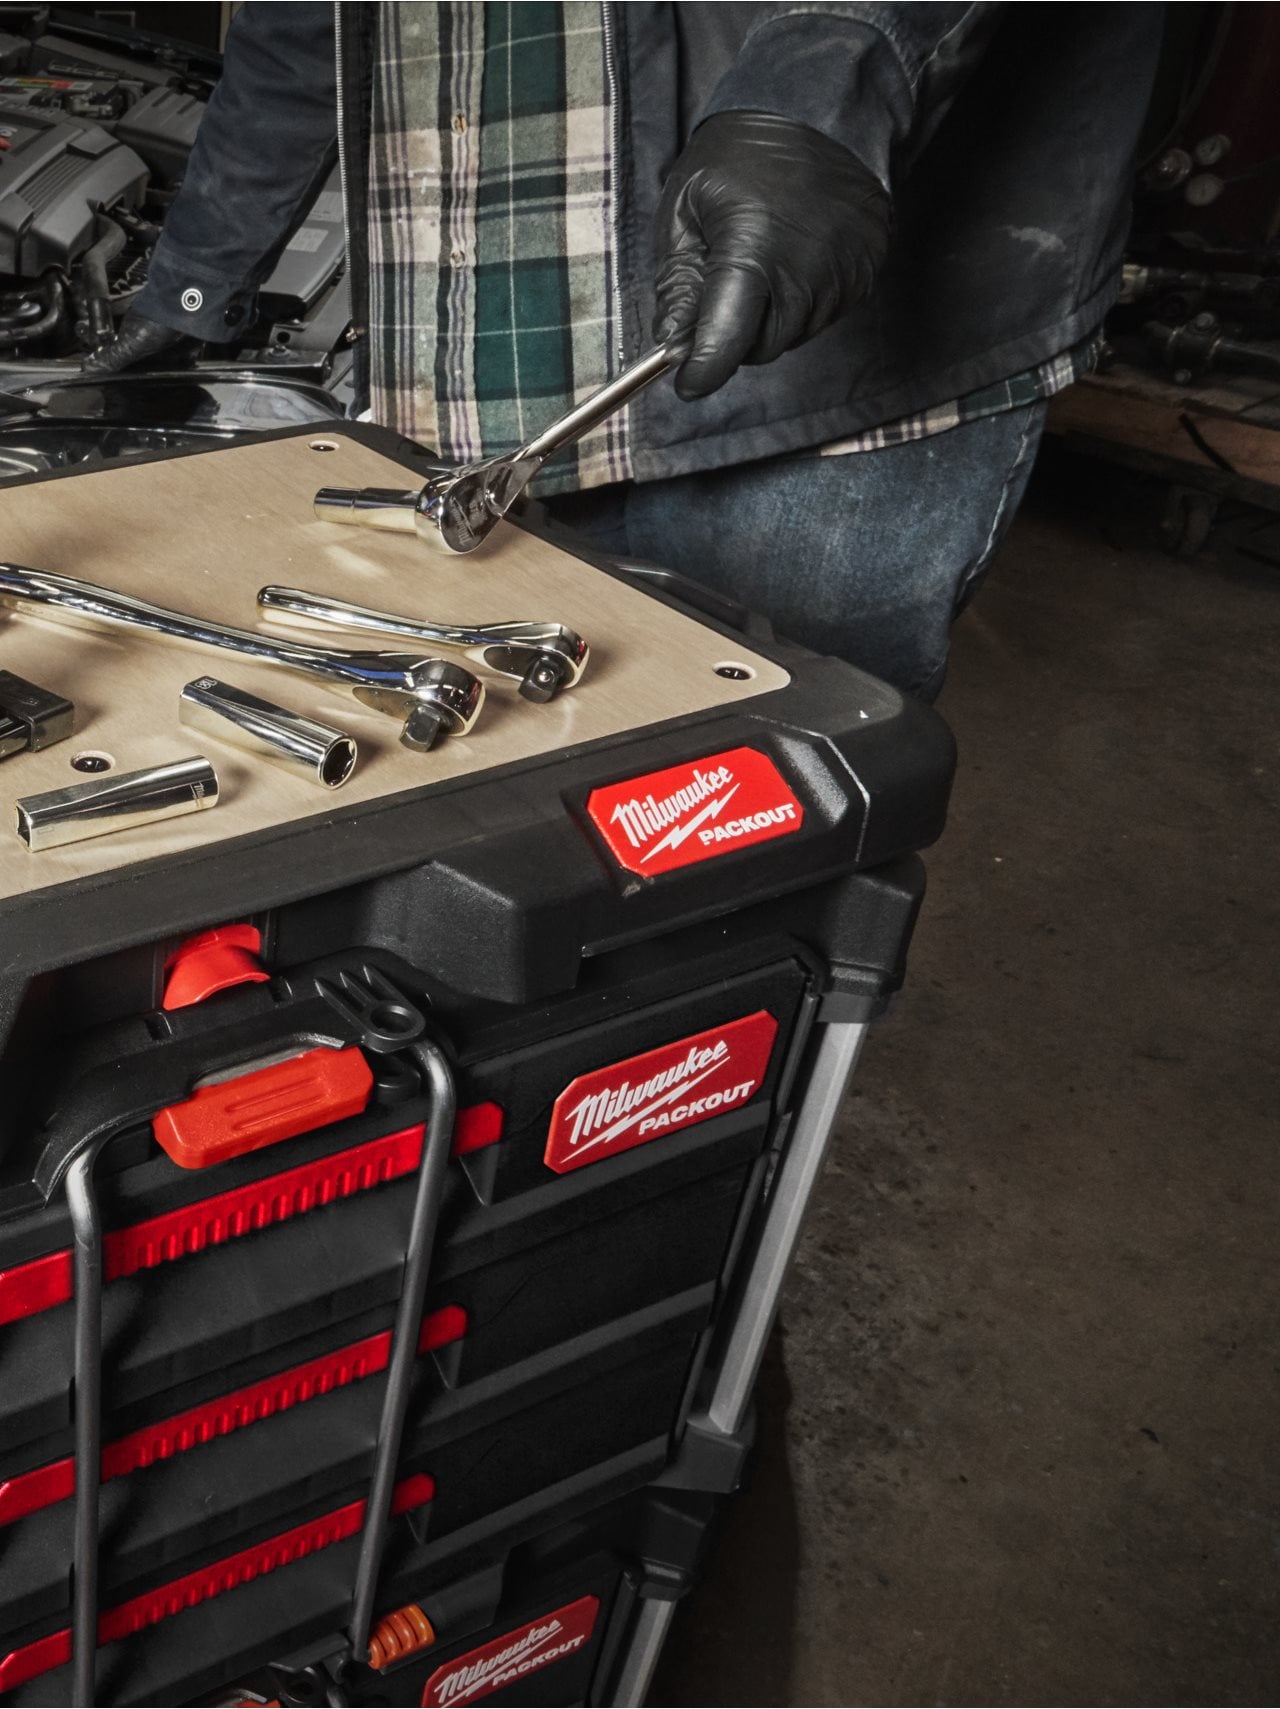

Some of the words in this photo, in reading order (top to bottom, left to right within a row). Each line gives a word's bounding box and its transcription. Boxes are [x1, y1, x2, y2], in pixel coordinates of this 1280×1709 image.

[610, 765, 734, 848] Milwaukee
[697, 803, 797, 845] PACKOUT
[565, 1040, 728, 1145] Milwaukee
[638, 1080, 755, 1136] PACKOUT
[433, 1619, 561, 1704] Milwaukee
[492, 1634, 585, 1686] PACKOUT
